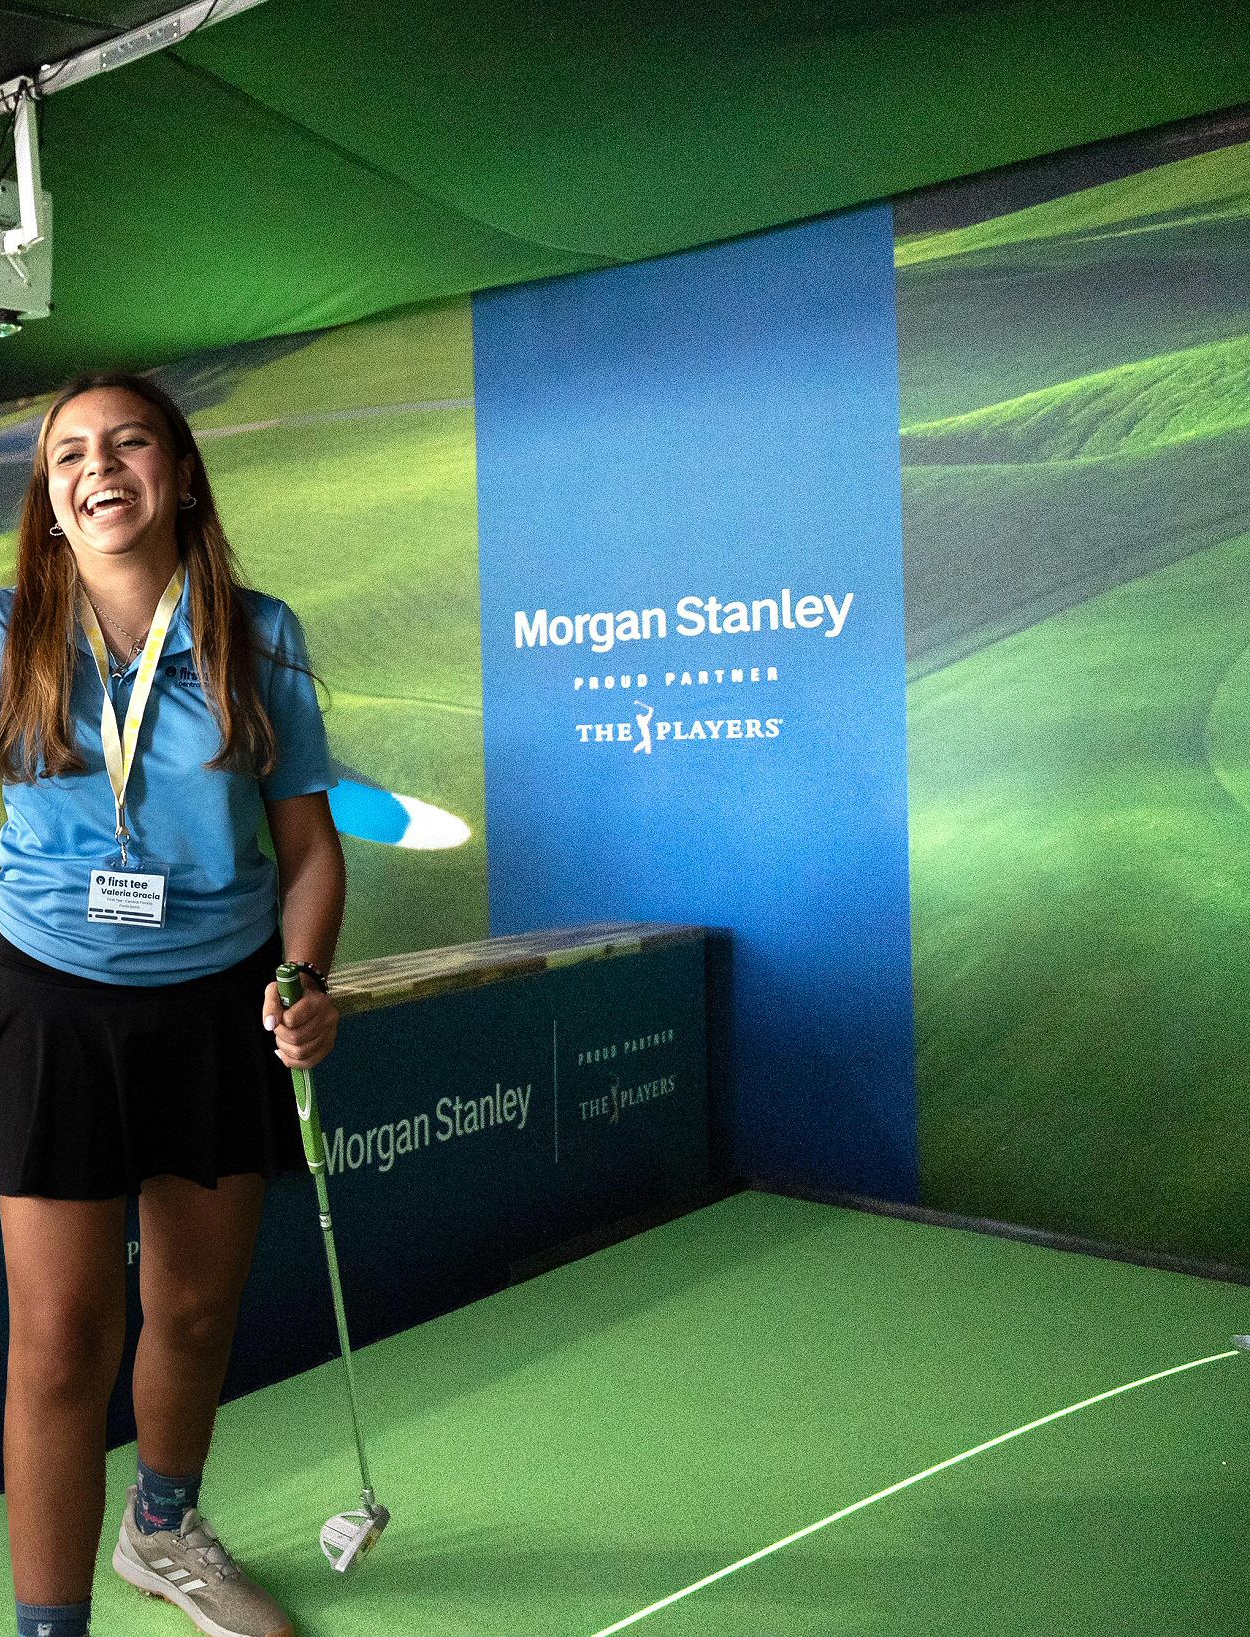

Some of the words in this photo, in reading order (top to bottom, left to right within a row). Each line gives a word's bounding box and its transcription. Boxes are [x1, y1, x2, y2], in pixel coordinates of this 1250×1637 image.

[514, 608, 667, 653] Morgan
[676, 588, 854, 638] Stanley
[179, 667, 198, 681] firs
[574, 673, 649, 691] PROUD
[665, 666, 779, 686] PARTNER
[576, 721, 633, 743] THE
[656, 718, 781, 741] PLAYERS
[101, 888, 131, 898] Valeria
[132, 891, 160, 900] Gracia
[108, 876, 128, 888] first
[130, 879, 148, 890] tee
[578, 1045, 617, 1066] PROUD
[624, 1029, 674, 1053] PARTNER
[579, 1096, 609, 1121] THE
[621, 1074, 676, 1108] PLAYERS
[322, 1112, 430, 1176] Morgan
[435, 1083, 532, 1142] Stanley
